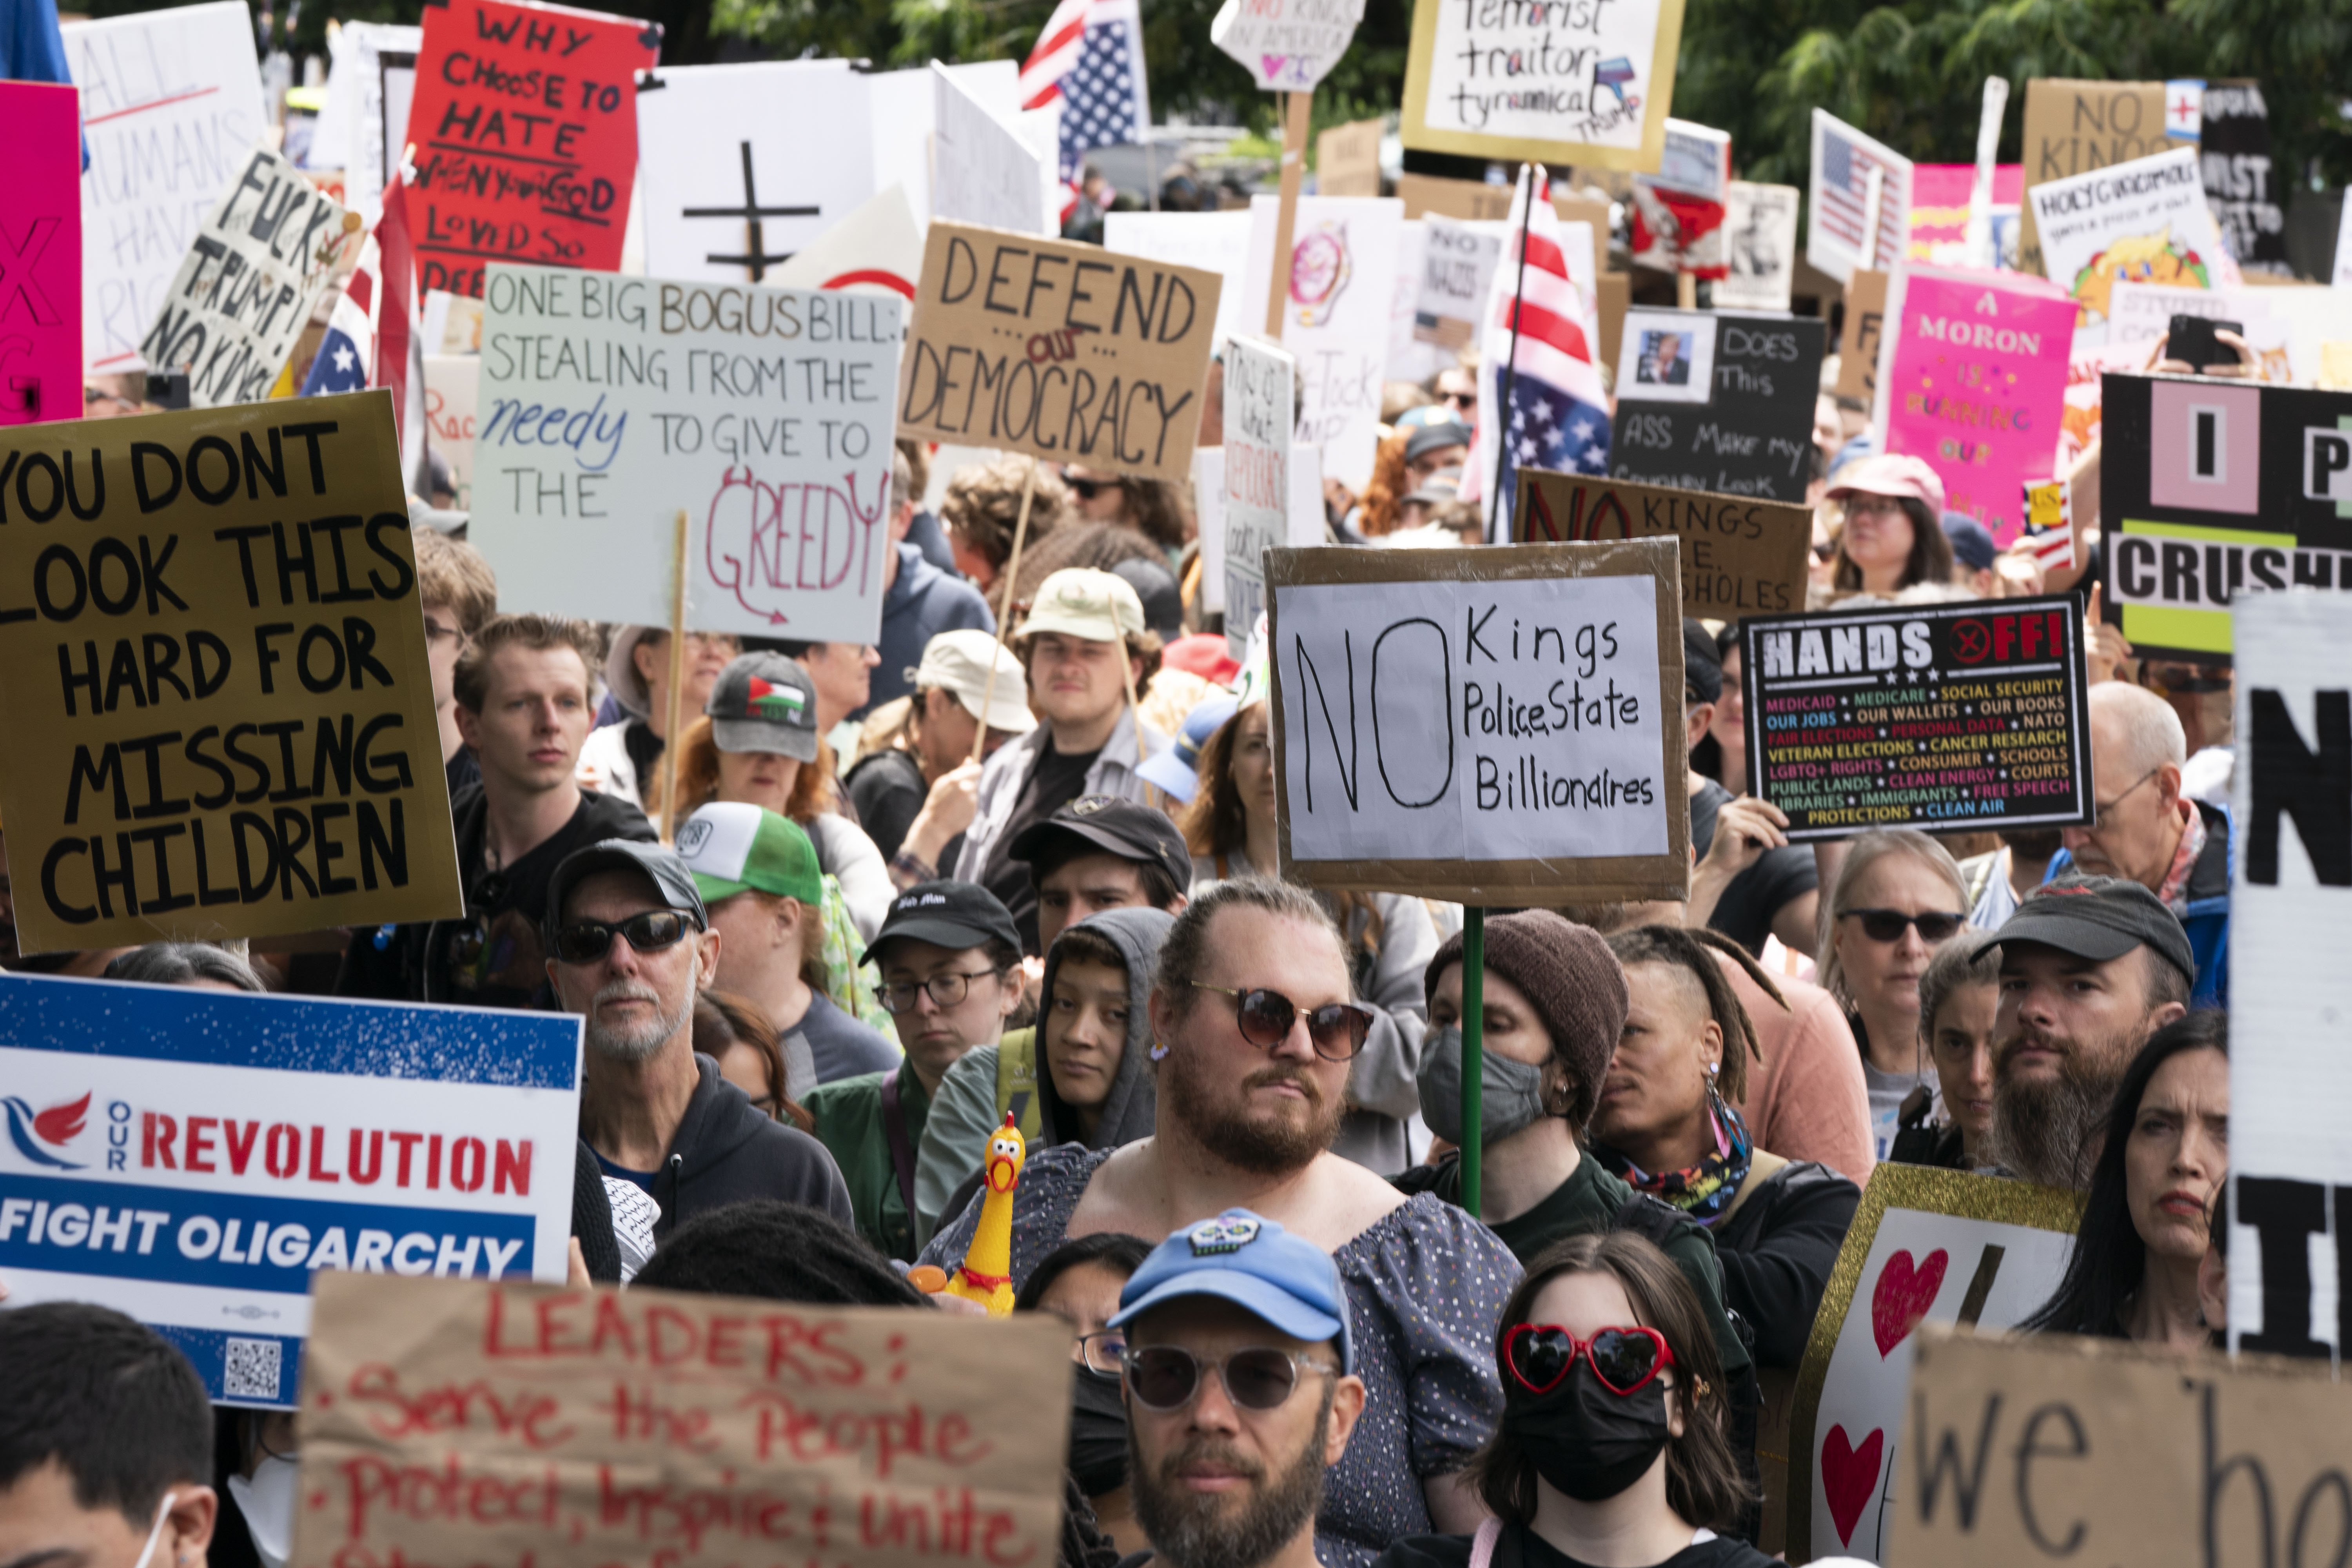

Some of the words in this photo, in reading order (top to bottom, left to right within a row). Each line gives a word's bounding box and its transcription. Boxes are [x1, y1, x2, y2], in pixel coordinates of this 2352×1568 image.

[476, 9, 594, 57] WHY
[1457, 31, 1599, 78] traitor
[582, 81, 621, 113] TO
[2072, 91, 2142, 136] NO
[89, 108, 251, 207] UMANS
[437, 100, 586, 158] HATE
[216, 150, 333, 274] FUCK
[549, 171, 615, 214] GOD
[490, 272, 571, 318] ONE
[582, 277, 646, 332] BIG
[660, 282, 802, 339] BOGUS
[940, 236, 1196, 343] DEFEND
[1975, 290, 1998, 317] A
[139, 301, 208, 368] NO
[1026, 327, 1084, 365] our
[1723, 326, 1799, 363] DOES
[1918, 314, 2041, 356] MORON
[488, 334, 668, 391] STEALING
[688, 348, 786, 402] FROM
[794, 357, 879, 403] THE
[1715, 363, 1775, 397] This
[903, 338, 1194, 466] DEMOCRACY
[1623, 412, 1673, 450] ASS
[481, 392, 628, 472] needy
[651, 412, 703, 456] TO
[711, 414, 801, 464] GIVE
[819, 420, 870, 459] TO
[131, 420, 340, 515] DONT
[501, 468, 609, 517] THE
[706, 466, 890, 598] GREEDY
[1524, 480, 1632, 543] NO
[1643, 495, 1763, 539] KINGS
[214, 512, 416, 611] THIS
[2117, 537, 2352, 607] CRUSH
[58, 630, 233, 718] HARD
[254, 615, 395, 695] FOR
[1465, 603, 1619, 680] Kings
[1762, 620, 1933, 679] HANDS
[1296, 615, 1454, 815] NO
[1766, 694, 1836, 713] MEDICAID
[1854, 688, 1926, 707] MEDICARE
[1941, 684, 1992, 701] SOCIAL
[1995, 678, 2063, 698] SECURITY
[1766, 713, 1798, 731] OUR
[1801, 710, 1837, 728] JOBS
[1857, 708, 1888, 724] OUR
[1891, 702, 1958, 722] WALLETS
[1980, 699, 2011, 716] OUR
[2016, 695, 2065, 713] BOOKS
[1768, 731, 1799, 746] FAIR
[1801, 726, 1875, 745] ELECTIONS
[1892, 721, 1964, 739] PERSONAL
[1967, 717, 2005, 733] DATA
[2023, 711, 2065, 729] NATO
[1768, 746, 1833, 764] VETERAN
[1837, 739, 1915, 759] ELECTIONS
[1930, 734, 1989, 753] CANCER
[1992, 728, 2067, 747] RESEARCH
[63, 712, 416, 826] MISSING
[1769, 762, 1827, 780] LGBTQ+
[1830, 758, 1883, 776] RIGHTS
[1899, 751, 1982, 771] CONSUMER
[2000, 746, 2068, 765] SCHOOLS
[1769, 779, 1821, 797] PUBLIC
[1824, 775, 1872, 793] LANDS
[1889, 771, 1935, 789] CLEAN
[1939, 767, 1996, 785] ENERGY
[2011, 762, 2070, 780] COURTS
[1860, 785, 1958, 806] IMMIGRANTS
[1973, 783, 2010, 800] FREE
[2013, 778, 2070, 797] SPEECH
[1808, 804, 1911, 826] PROTECTIONS
[1926, 800, 1976, 818] CLEAN
[1979, 798, 2005, 815] AIR
[40, 797, 410, 926] CHILDREN
[108, 1100, 132, 1172] OUR
[140, 1109, 534, 1197] REVOLUTION
[0, 1196, 170, 1256] FIGHT
[176, 1214, 524, 1280] OLIGARCHY
[347, 1359, 577, 1452] Serve
[588, 1377, 725, 1456] the
[737, 1390, 993, 1479] People
